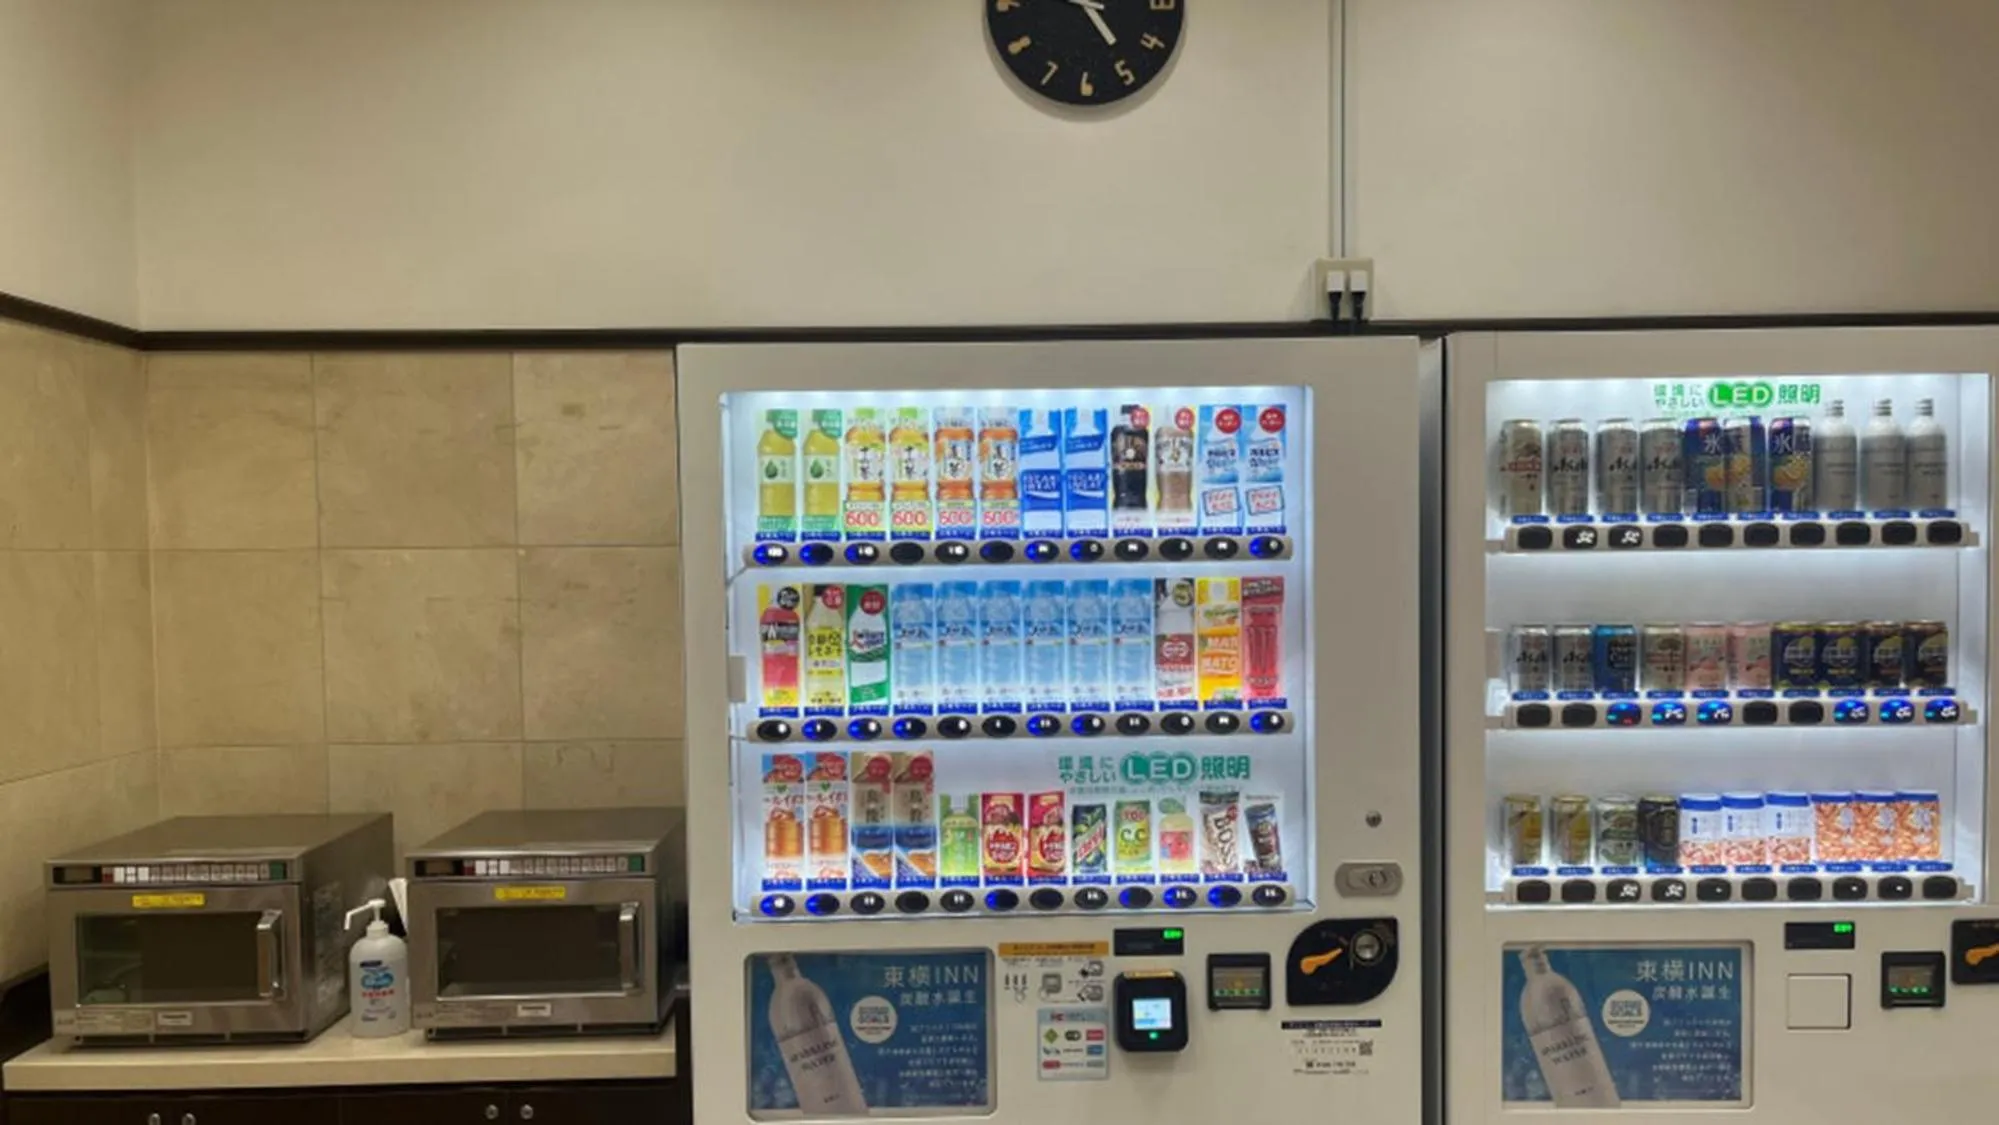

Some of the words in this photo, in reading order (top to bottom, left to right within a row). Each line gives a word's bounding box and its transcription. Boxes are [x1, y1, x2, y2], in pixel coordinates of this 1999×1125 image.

[1008, 36, 1032, 54] 8
[1140, 33, 1165, 49] 4
[1041, 61, 1058, 85] 7
[1080, 71, 1093, 96] 6
[1114, 60, 1135, 85] 5
[1713, 385, 1770, 405] LED
[1778, 383, 1821, 404] 照明
[1127, 757, 1193, 780] LED
[1201, 754, 1250, 780] 照明
[1634, 959, 1733, 981] 東横INN
